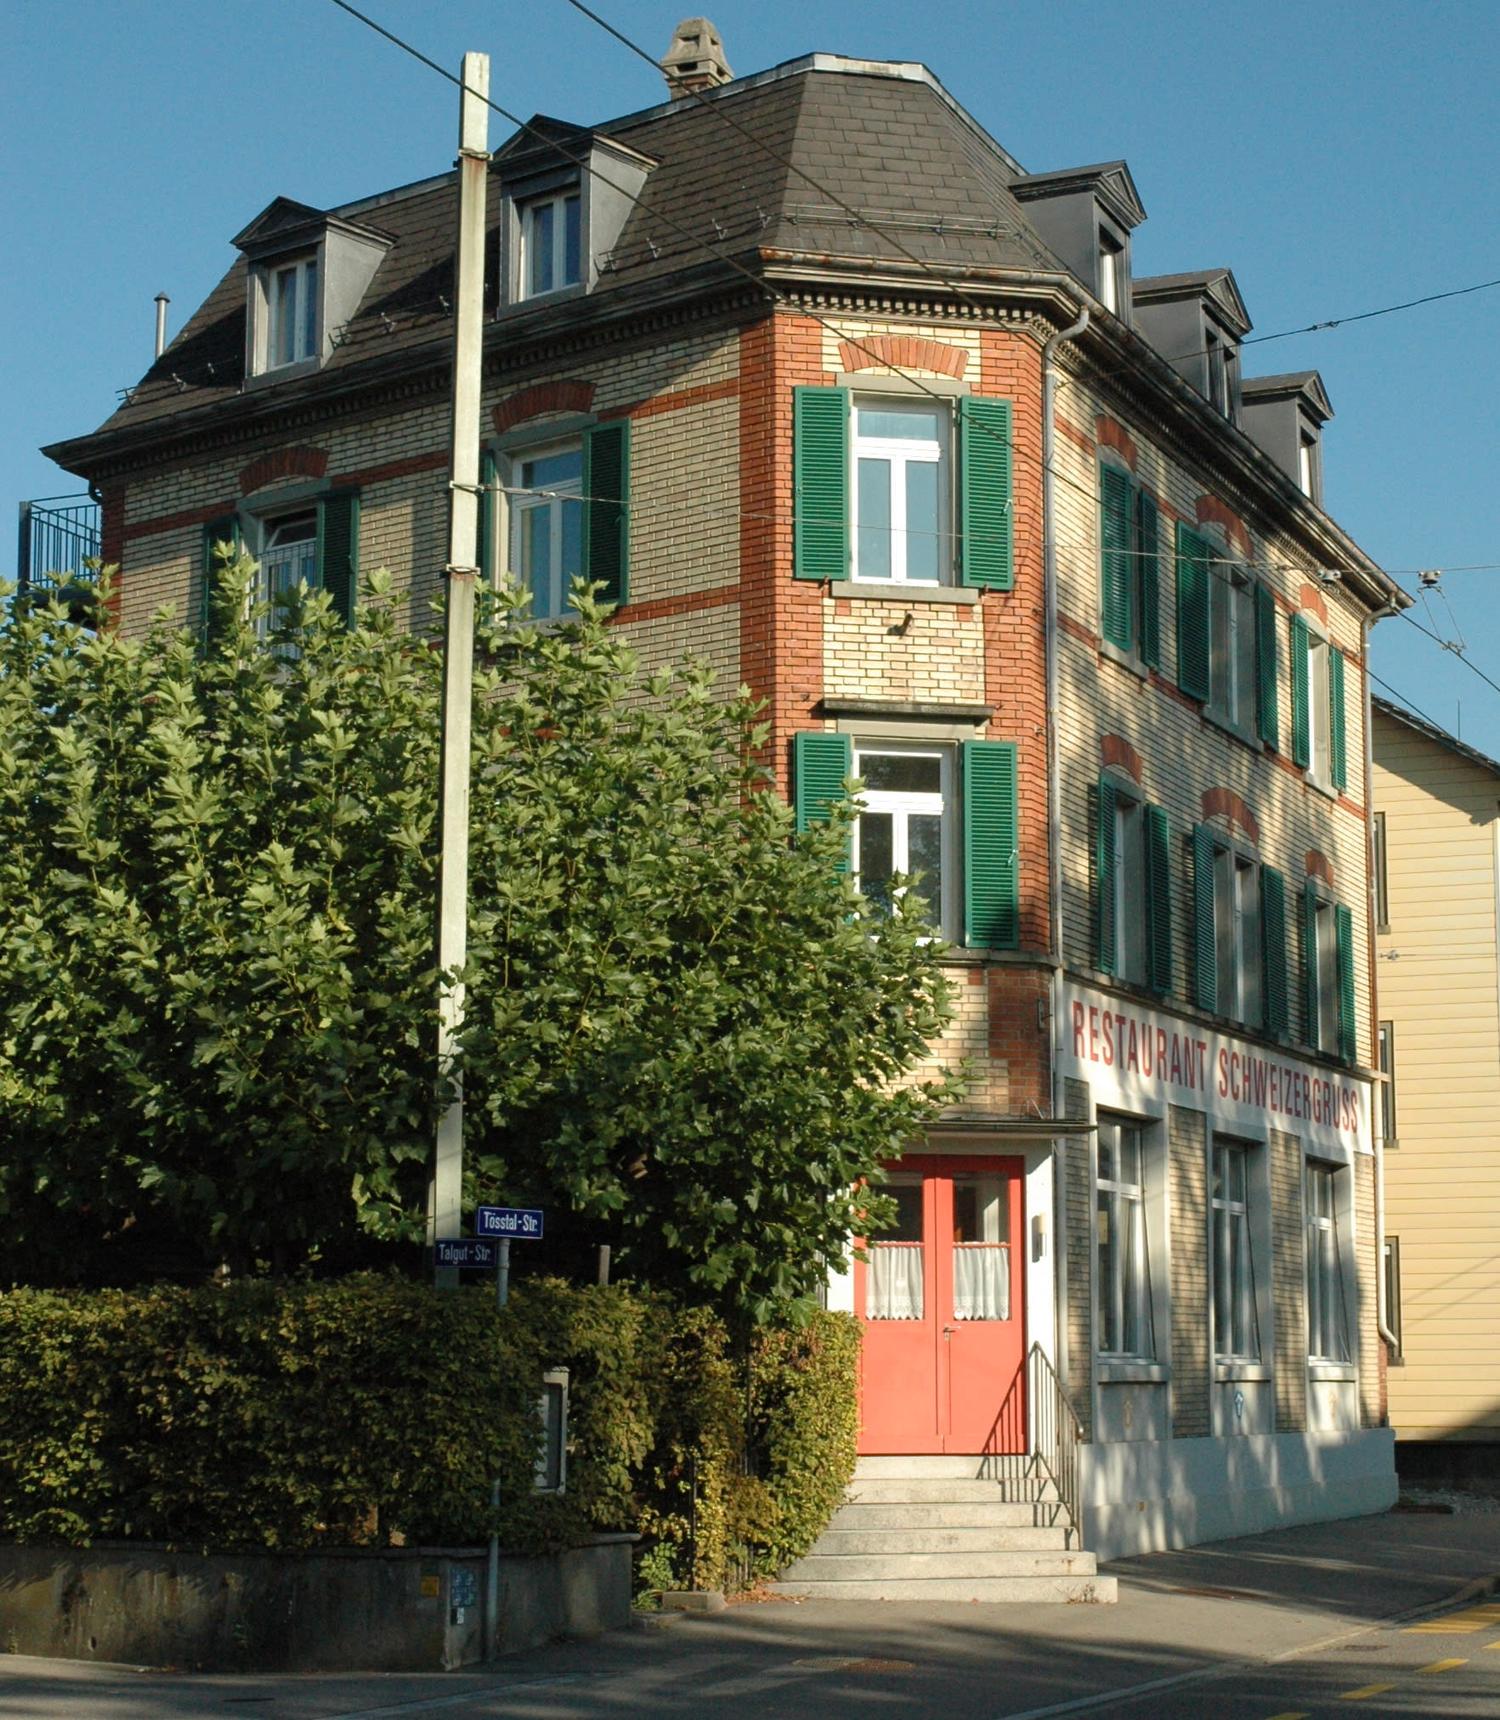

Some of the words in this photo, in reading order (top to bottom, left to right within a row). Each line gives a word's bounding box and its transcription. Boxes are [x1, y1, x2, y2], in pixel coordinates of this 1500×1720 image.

[1073, 1001, 1207, 1092] RESTAURANT
[1219, 1047, 1359, 1134] SCHWEIZERGRUSS
[483, 1211, 538, 1232] Tösstal-Str.
